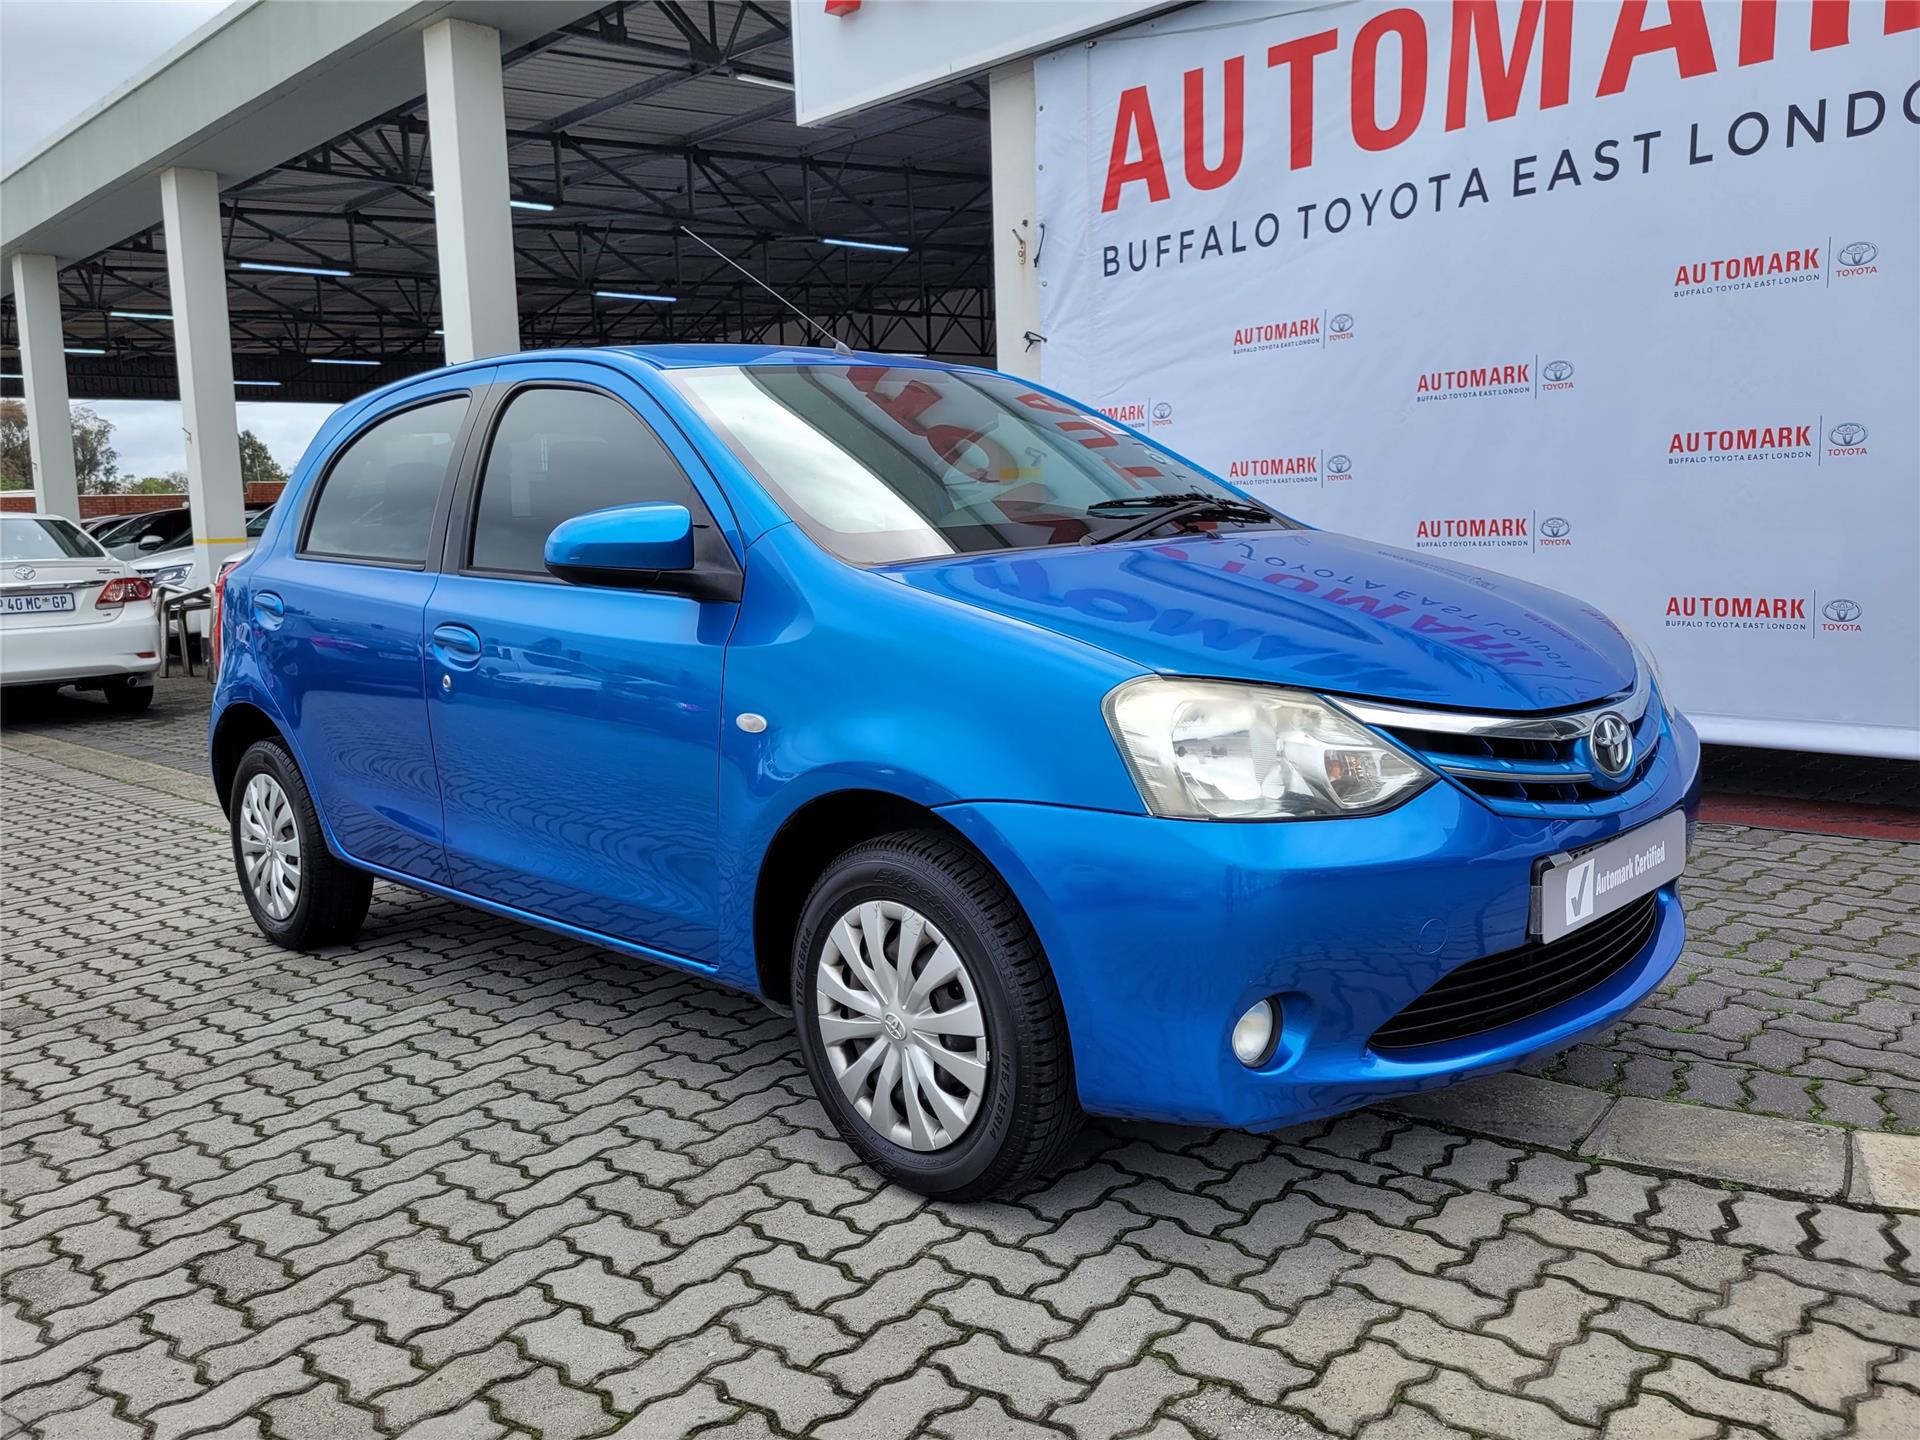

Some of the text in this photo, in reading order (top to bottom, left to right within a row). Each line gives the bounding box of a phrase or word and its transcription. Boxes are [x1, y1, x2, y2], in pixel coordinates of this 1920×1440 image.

[1101, 0, 1920, 213] AUTOMA
[1103, 212, 1278, 277] BUFFALO
[1297, 167, 1490, 240] TOYOTA
[1512, 130, 1662, 197] EAST
[1674, 247, 1820, 287] AUTOMARK
[1836, 266, 1878, 278] TOYOTA
[1674, 274, 1820, 298] BUFFALO TOYOTA EAST LONDON
[1233, 317, 1320, 346] AUTOMARK
[1329, 332, 1354, 341] TOYOTA
[1417, 364, 1529, 393] AUTOMARK
[1542, 382, 1574, 391] TOYOTA
[1416, 386, 1530, 403] BUFFALO TOYOTA EAST LONDON
[1668, 426, 1811, 453] AUTOMARK
[1668, 450, 1812, 465] BUFFALO TOYOTA EAST LONDON
[1827, 447, 1868, 457] TOYOTA
[1229, 457, 1317, 478] AUTOMARK
[1417, 518, 1527, 538] AUTOMARK
[1416, 541, 1448, 549] BUFFALO
[1540, 538, 1572, 546] TOYOTA
[8, 598, 23, 611] 40
[26, 597, 41, 610] MC
[52, 596, 67, 608] GP
[1665, 596, 1805, 619] AUTOMARK
[1665, 620, 1703, 628] BUFFALO
[1705, 621, 1740, 629] TOYOTA
[1766, 623, 1806, 631] LONDON
[1821, 623, 1862, 632] TOYOTA
[1595, 840, 1666, 896] Automark Certified
[989, 1052, 1010, 1140] 175/65R14
